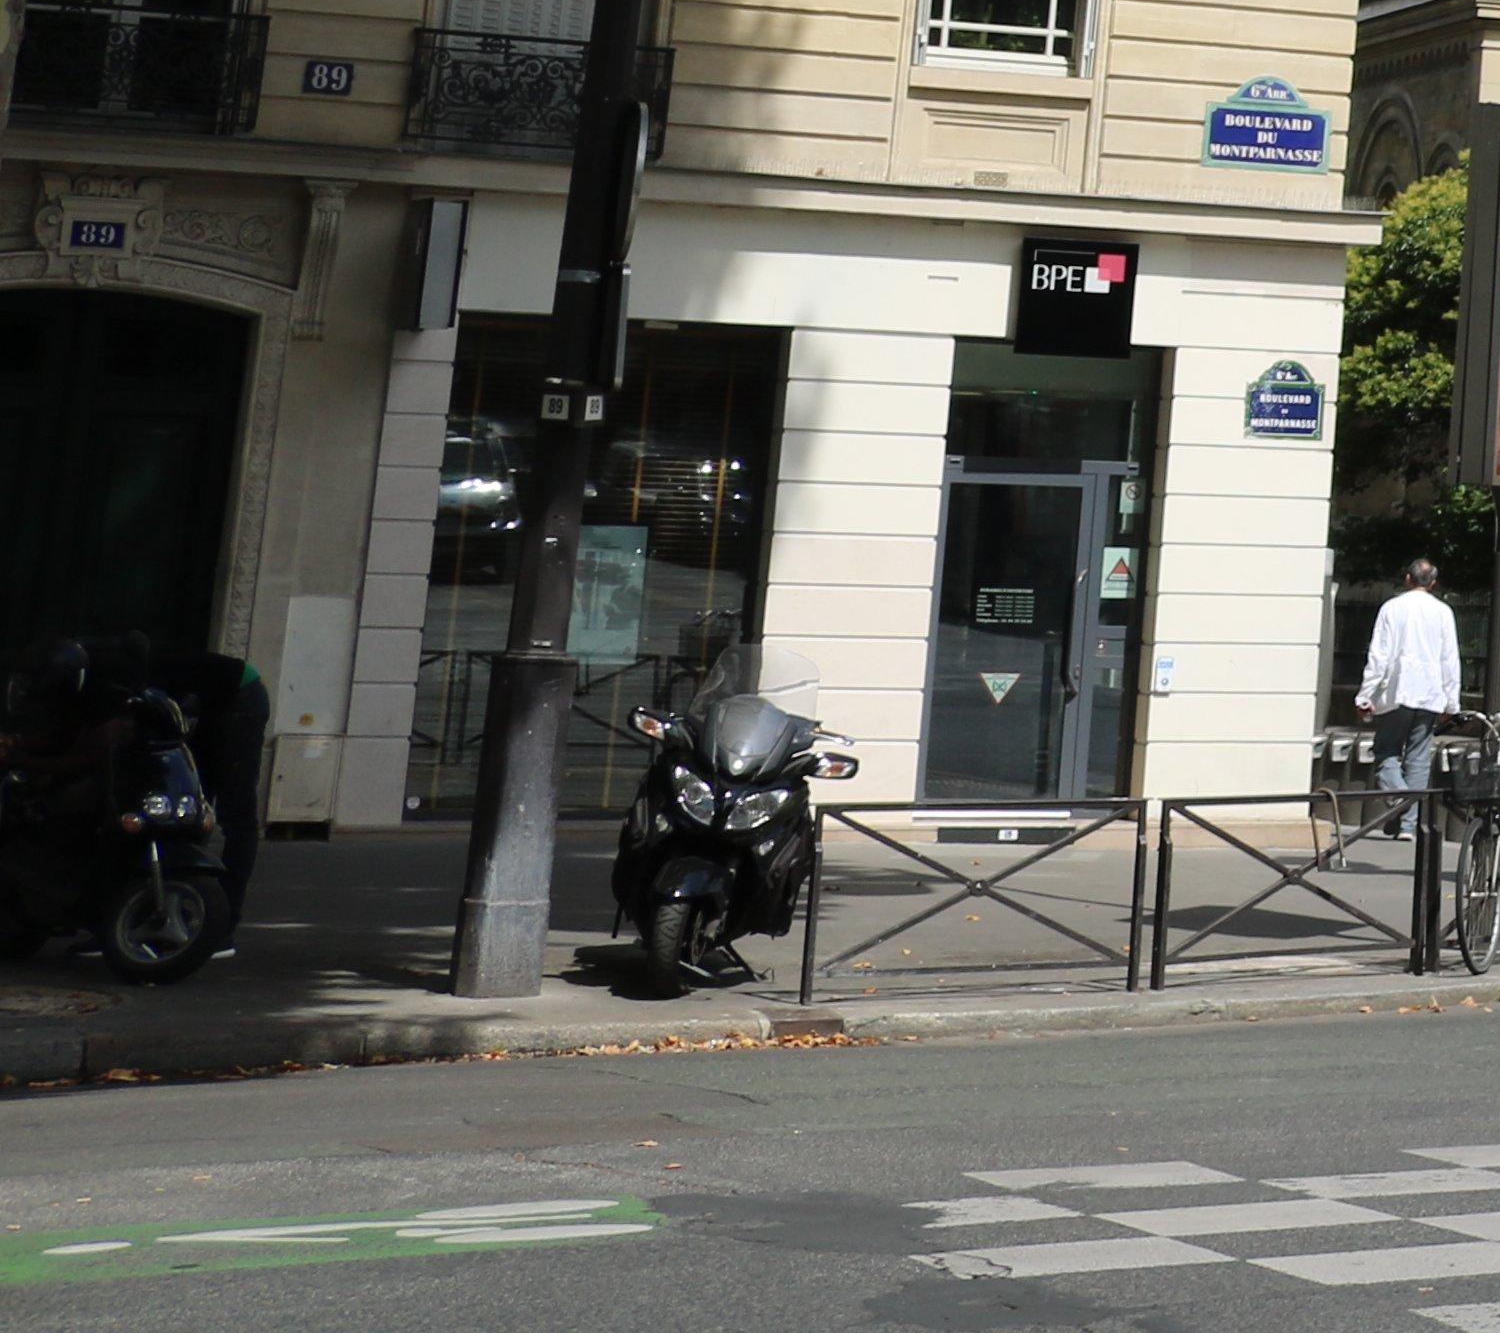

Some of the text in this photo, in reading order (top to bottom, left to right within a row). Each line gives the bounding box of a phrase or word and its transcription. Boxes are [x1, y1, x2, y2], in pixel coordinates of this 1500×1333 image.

[312, 64, 348, 91] 89
[1225, 114, 1312, 131] BOULEVARD
[1257, 131, 1278, 144] DU
[1210, 143, 1322, 162] MONTPARNASSE
[80, 223, 115, 245] 89
[1031, 263, 1084, 293] BPE
[549, 397, 563, 414] 89
[1260, 394, 1311, 405] BOULEVARD
[1251, 418, 1317, 429] MONTPARNASSE
